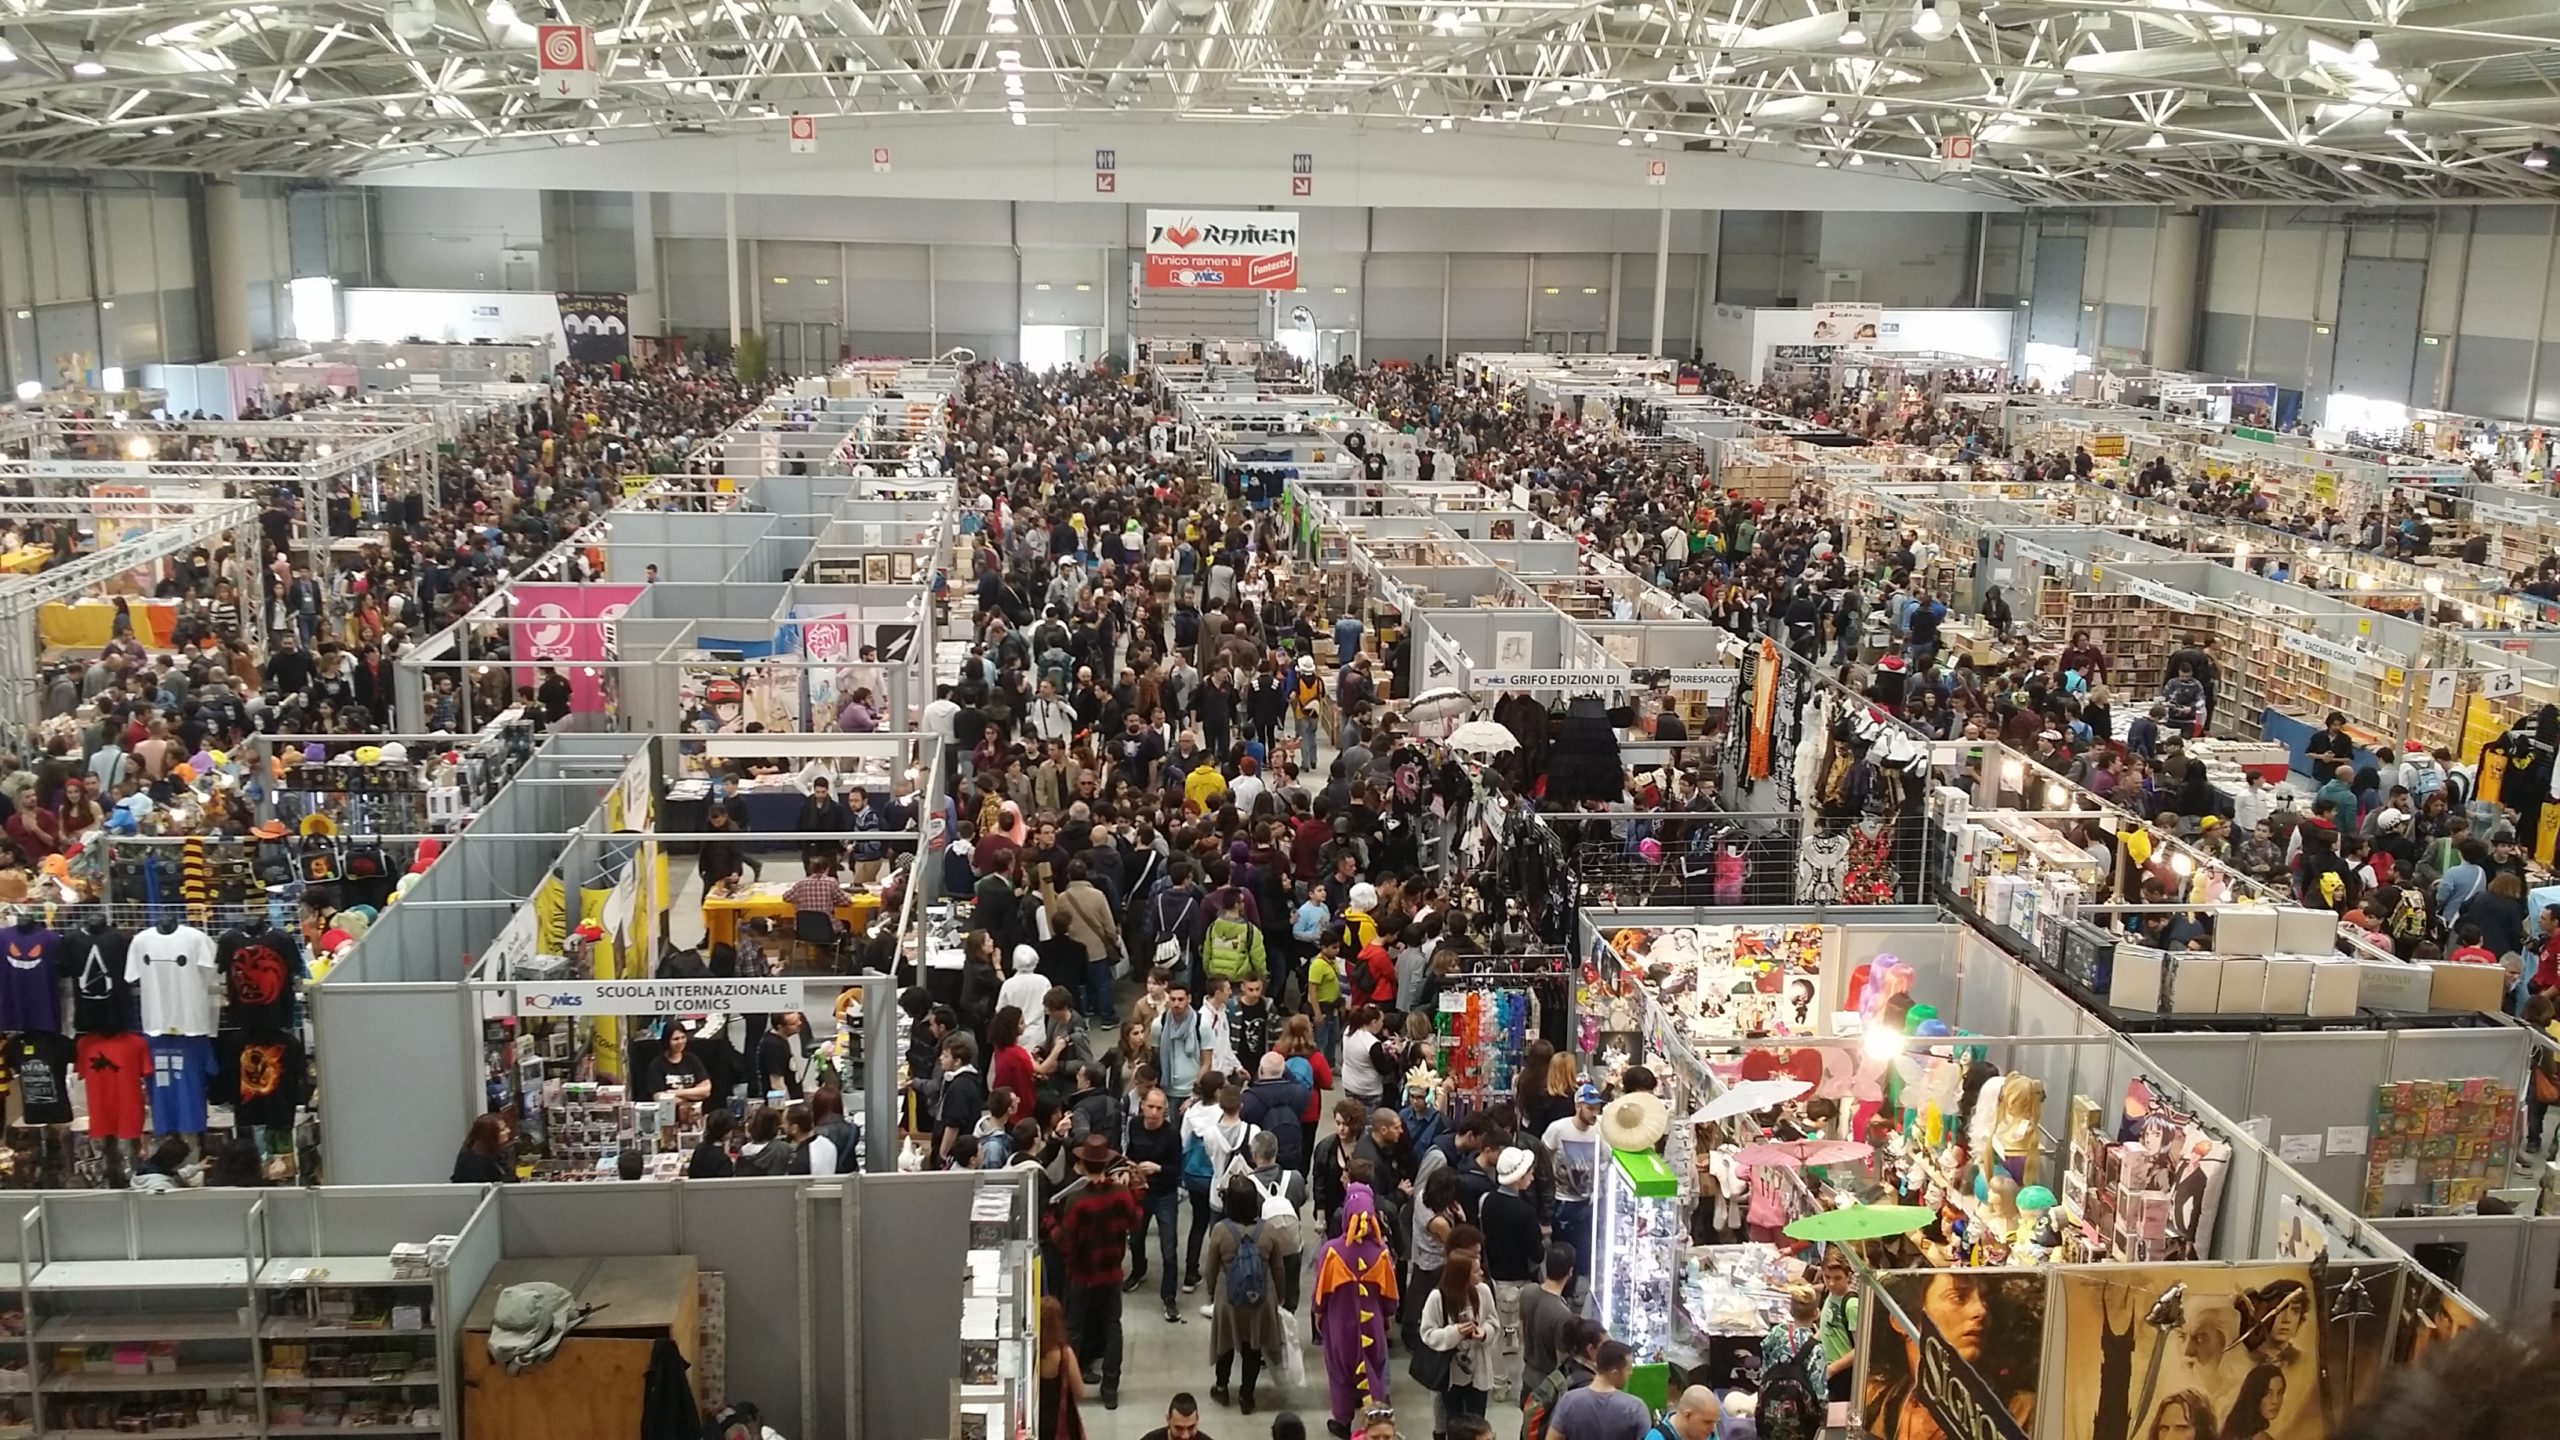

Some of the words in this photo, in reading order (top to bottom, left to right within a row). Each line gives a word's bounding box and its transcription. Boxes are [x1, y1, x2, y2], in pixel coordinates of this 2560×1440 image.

[1151, 226, 1163, 244] I
[1152, 255, 1189, 266] l'unico
[1192, 257, 1229, 267] ramen
[1232, 256, 1242, 267] al
[1253, 257, 1291, 276] Fantastic
[1678, 384, 1698, 394] LEGO
[535, 647, 569, 656] J-POP
[2304, 640, 2333, 657] ZACCARIA
[2333, 650, 2357, 665] COMICS
[1510, 674, 1548, 685] GRIFO
[1550, 674, 1604, 685] EDIZIONI
[1606, 674, 1620, 685] DI
[596, 985, 656, 999] SCUOLA
[659, 984, 788, 998] INTERNAZIONALE
[654, 1000, 670, 1011] DI
[673, 998, 731, 1011] COMICS
